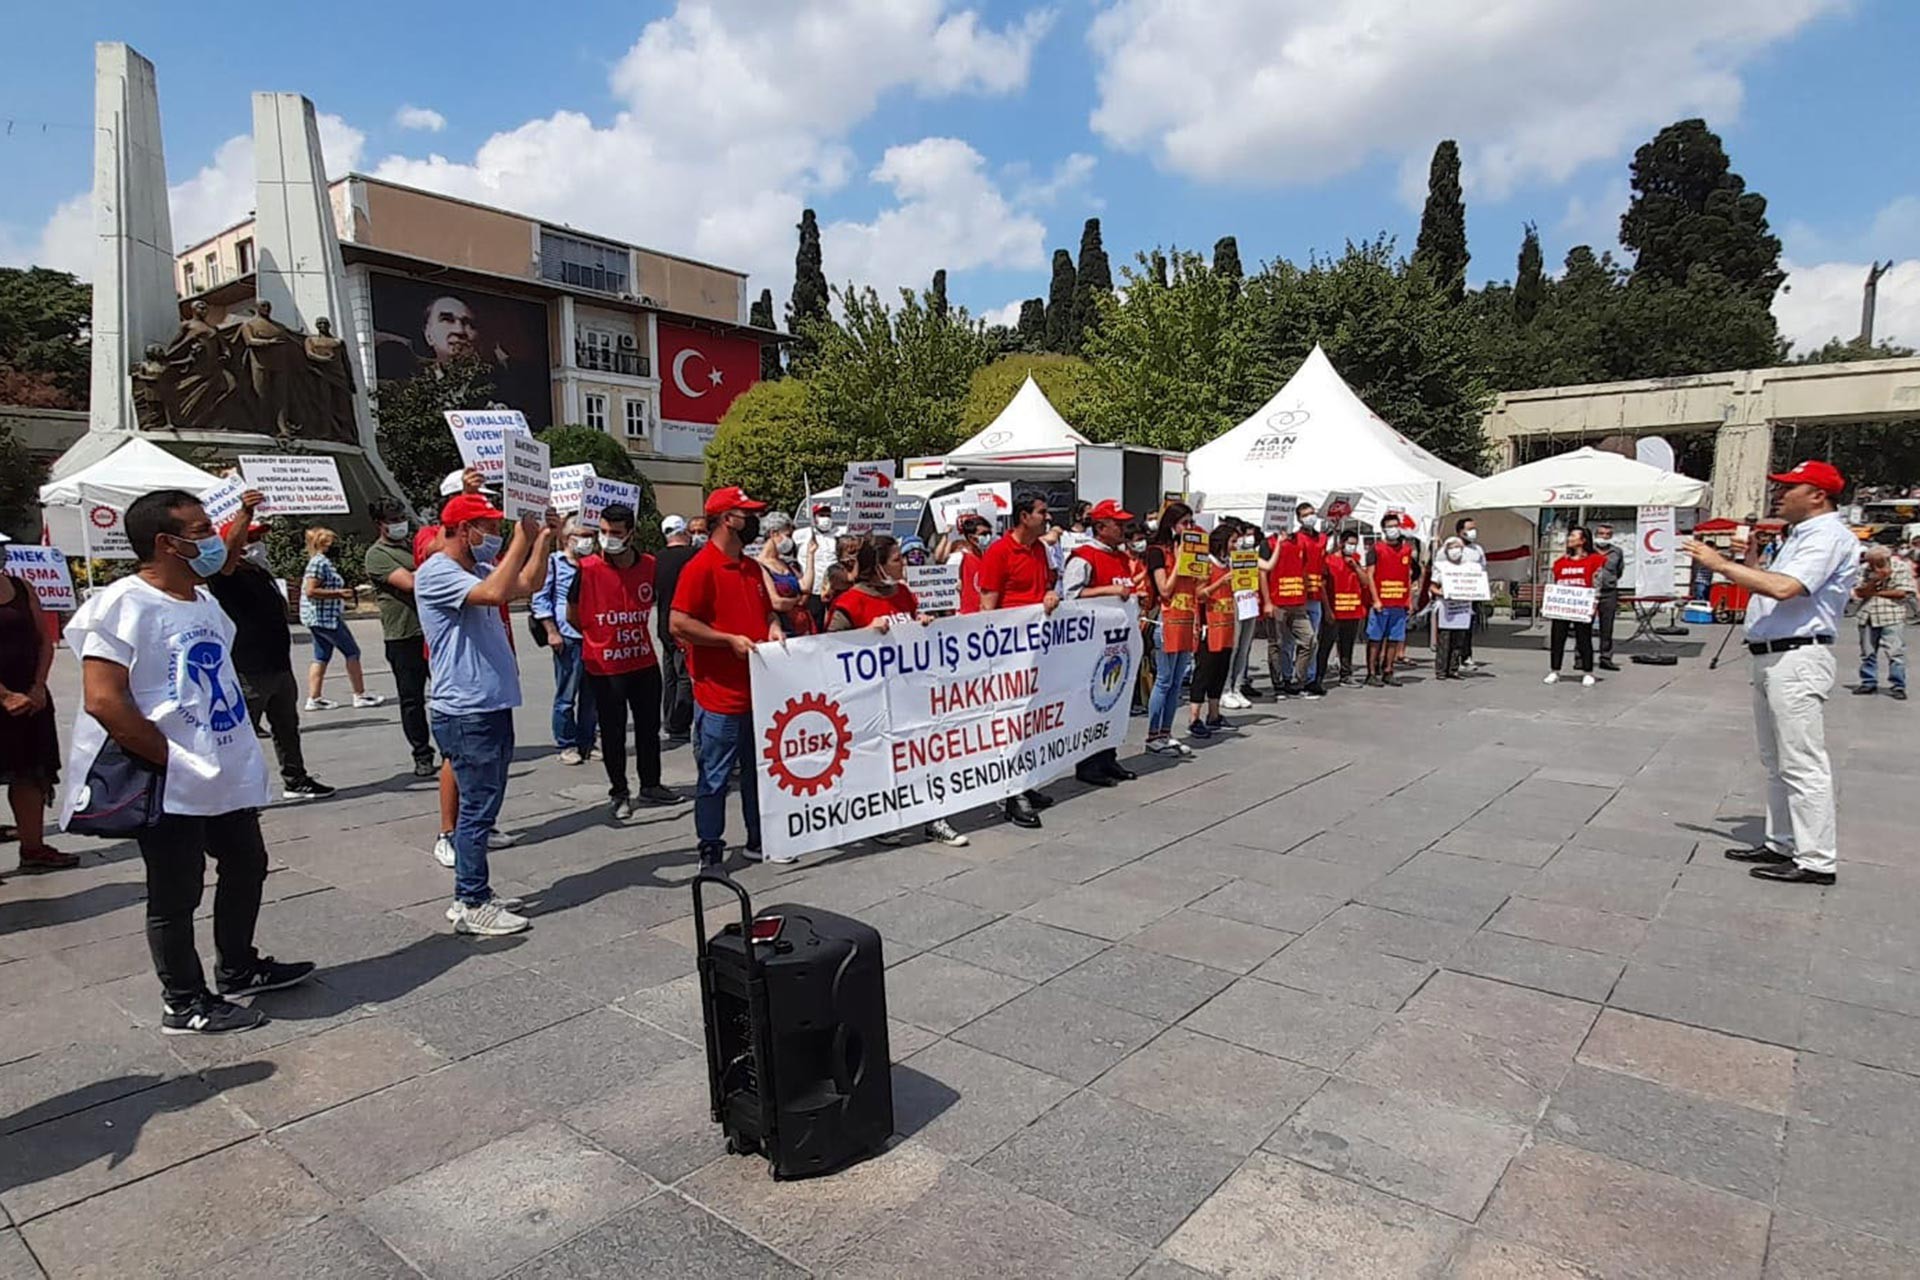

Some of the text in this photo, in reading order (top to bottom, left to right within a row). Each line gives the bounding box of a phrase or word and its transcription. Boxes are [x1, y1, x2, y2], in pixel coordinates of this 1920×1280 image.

[464, 416, 515, 425] KURALSIZ
[1254, 436, 1297, 446] KAN
[552, 470, 580, 479] OPLU
[598, 482, 628, 496] TOPLU
[6, 551, 46, 562] SNEK
[1556, 587, 1582, 597] TOPLU
[837, 610, 1095, 684] TOPLU İŞ SÖZLEŞMESİ
[930, 667, 1039, 716] HAKKIMIZ
[784, 729, 834, 758] DİSK
[892, 701, 1064, 773] ENGELLENEMEZ
[788, 720, 1111, 838] DİSK/GENEL İŞ SENDİKASI 2 NO'LU ŞUBE
